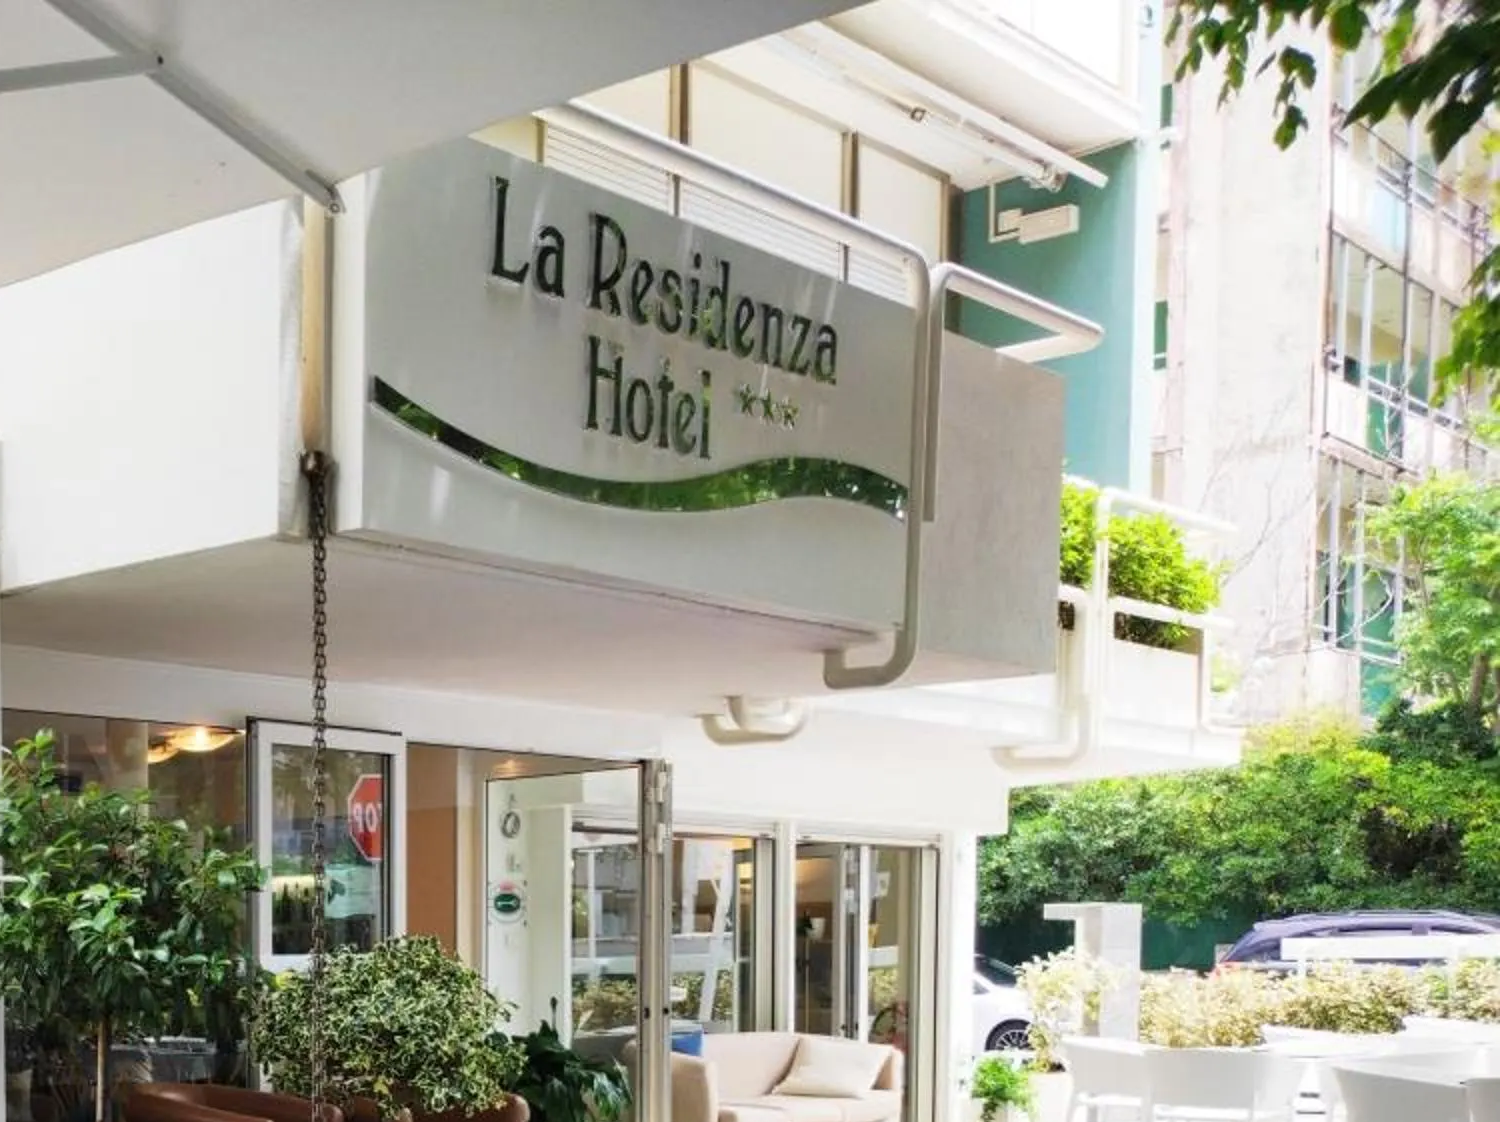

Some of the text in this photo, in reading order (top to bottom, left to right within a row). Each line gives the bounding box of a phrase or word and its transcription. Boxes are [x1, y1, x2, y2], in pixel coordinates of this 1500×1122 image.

[492, 175, 838, 386] La Residenza
[586, 336, 711, 459] Hotel
